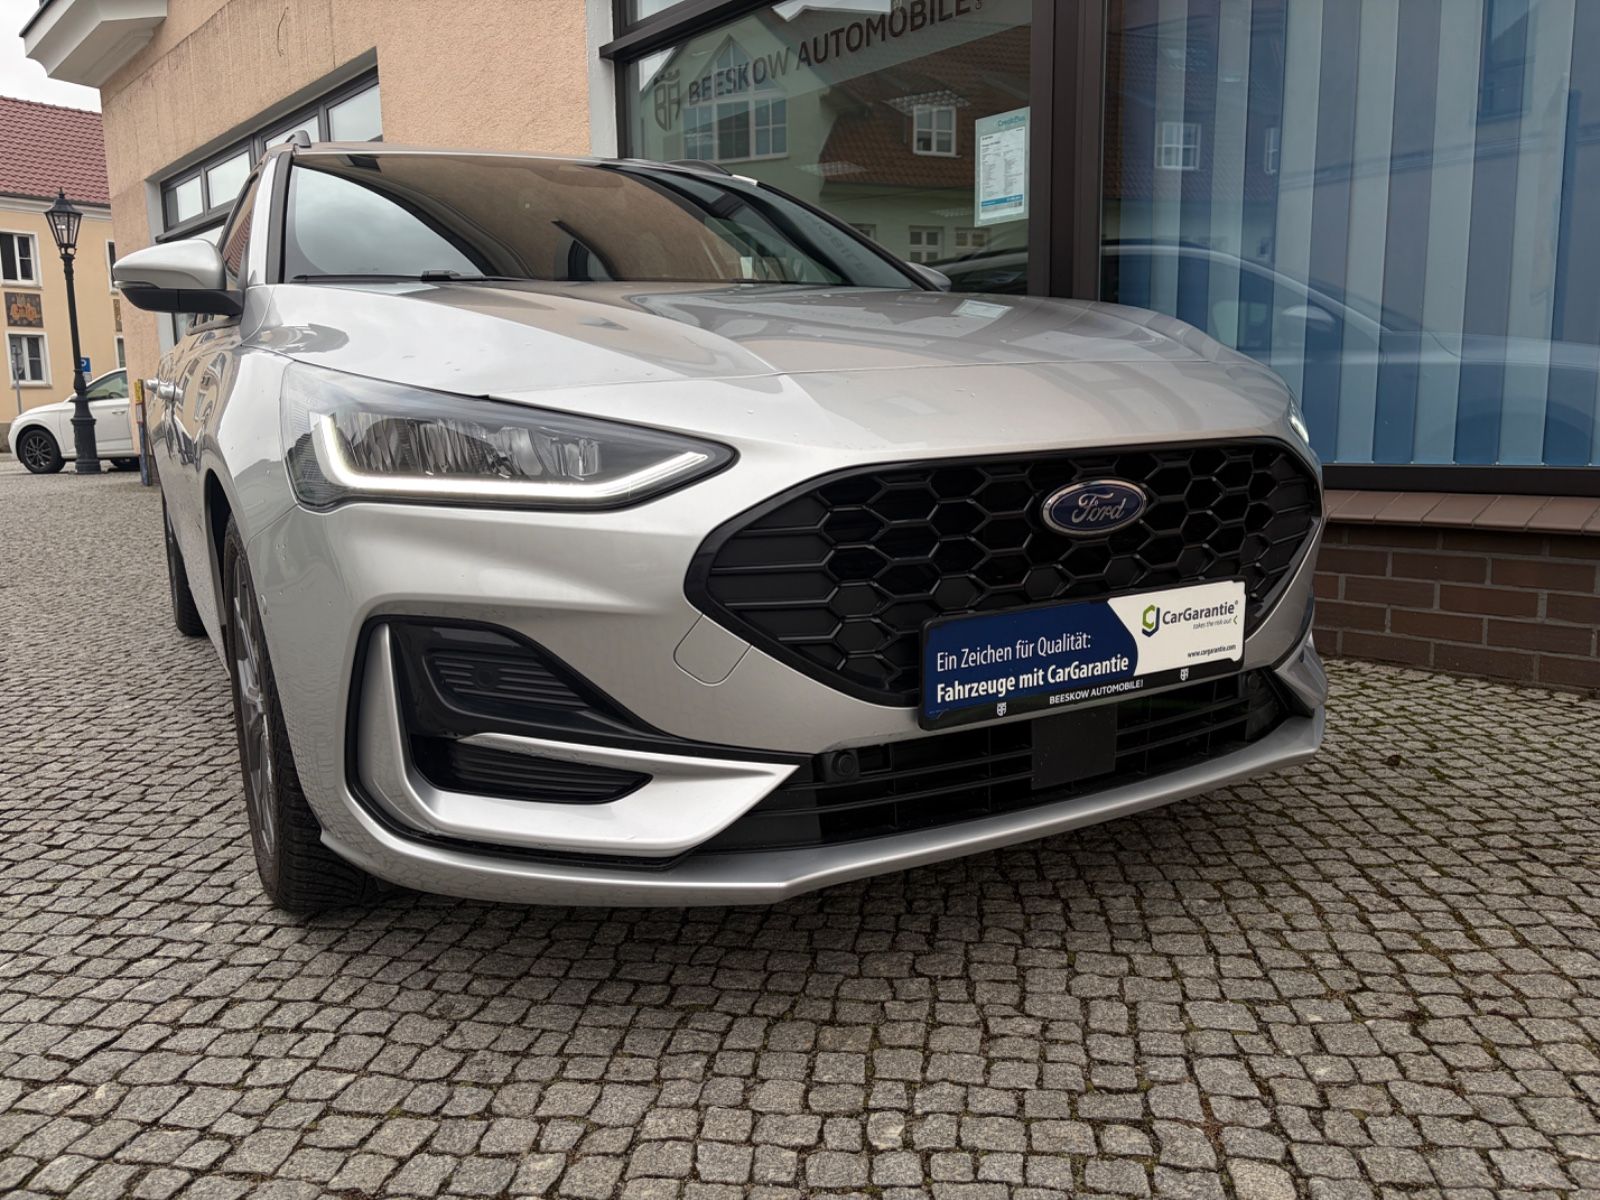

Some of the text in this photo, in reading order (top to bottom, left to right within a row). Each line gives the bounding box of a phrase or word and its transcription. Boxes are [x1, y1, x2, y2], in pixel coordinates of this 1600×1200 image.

[688, 47, 791, 106] BEESKOW
[1071, 492, 1127, 523] Ford
[937, 632, 1092, 672] Ein Zeichen für Qualität:
[937, 676, 1016, 703] Fahrzeuge
[1019, 668, 1044, 689] mit
[1047, 654, 1129, 684] CarGarantie
[1049, 689, 1090, 705] BEESKOW
